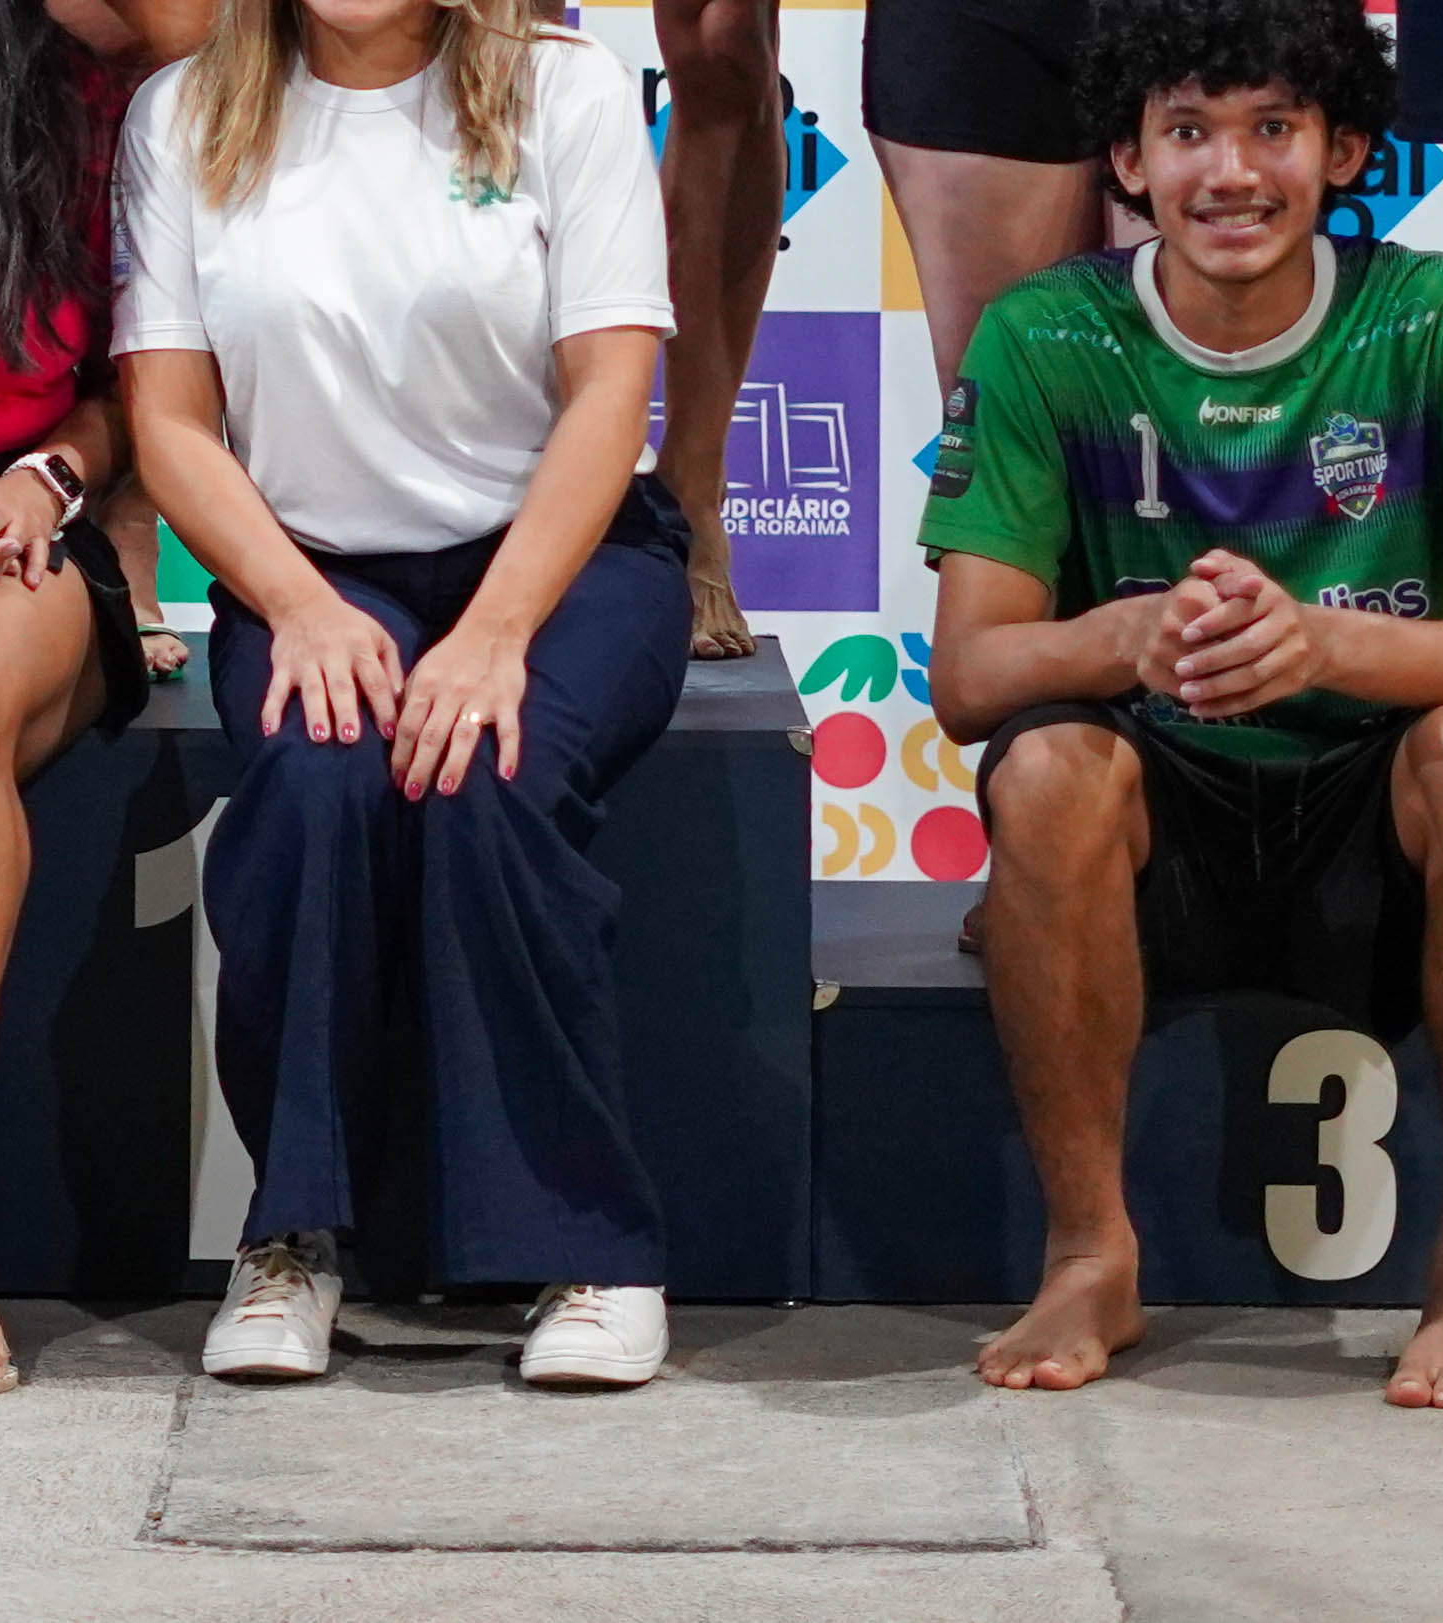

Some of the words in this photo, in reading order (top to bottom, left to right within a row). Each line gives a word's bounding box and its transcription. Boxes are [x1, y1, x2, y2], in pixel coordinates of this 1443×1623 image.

[1129, 413, 1171, 519] 1
[1313, 453, 1388, 486] SPORTING
[723, 519, 749, 535] DE
[754, 519, 851, 535] RORAIMA
[1265, 1029, 1398, 1281] 3
